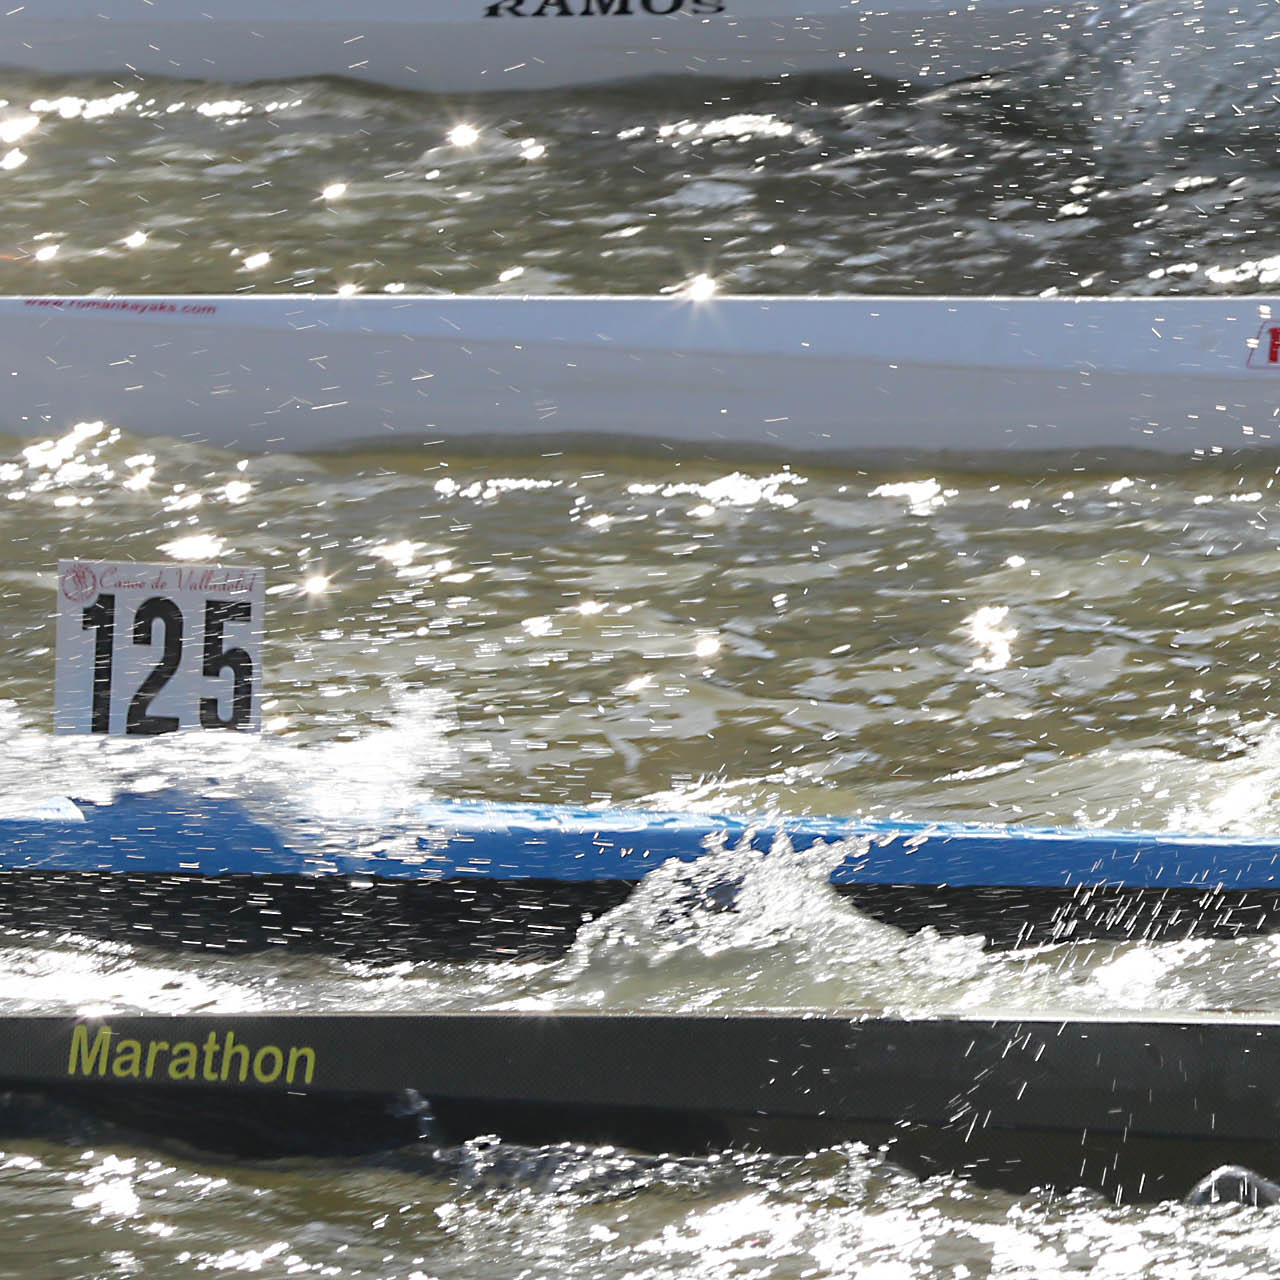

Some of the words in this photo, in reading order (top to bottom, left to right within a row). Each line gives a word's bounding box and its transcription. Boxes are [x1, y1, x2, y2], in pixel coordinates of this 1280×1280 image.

[151, 571, 165, 590] de
[82, 593, 253, 735] 125
[67, 1023, 316, 1085] Marathon
